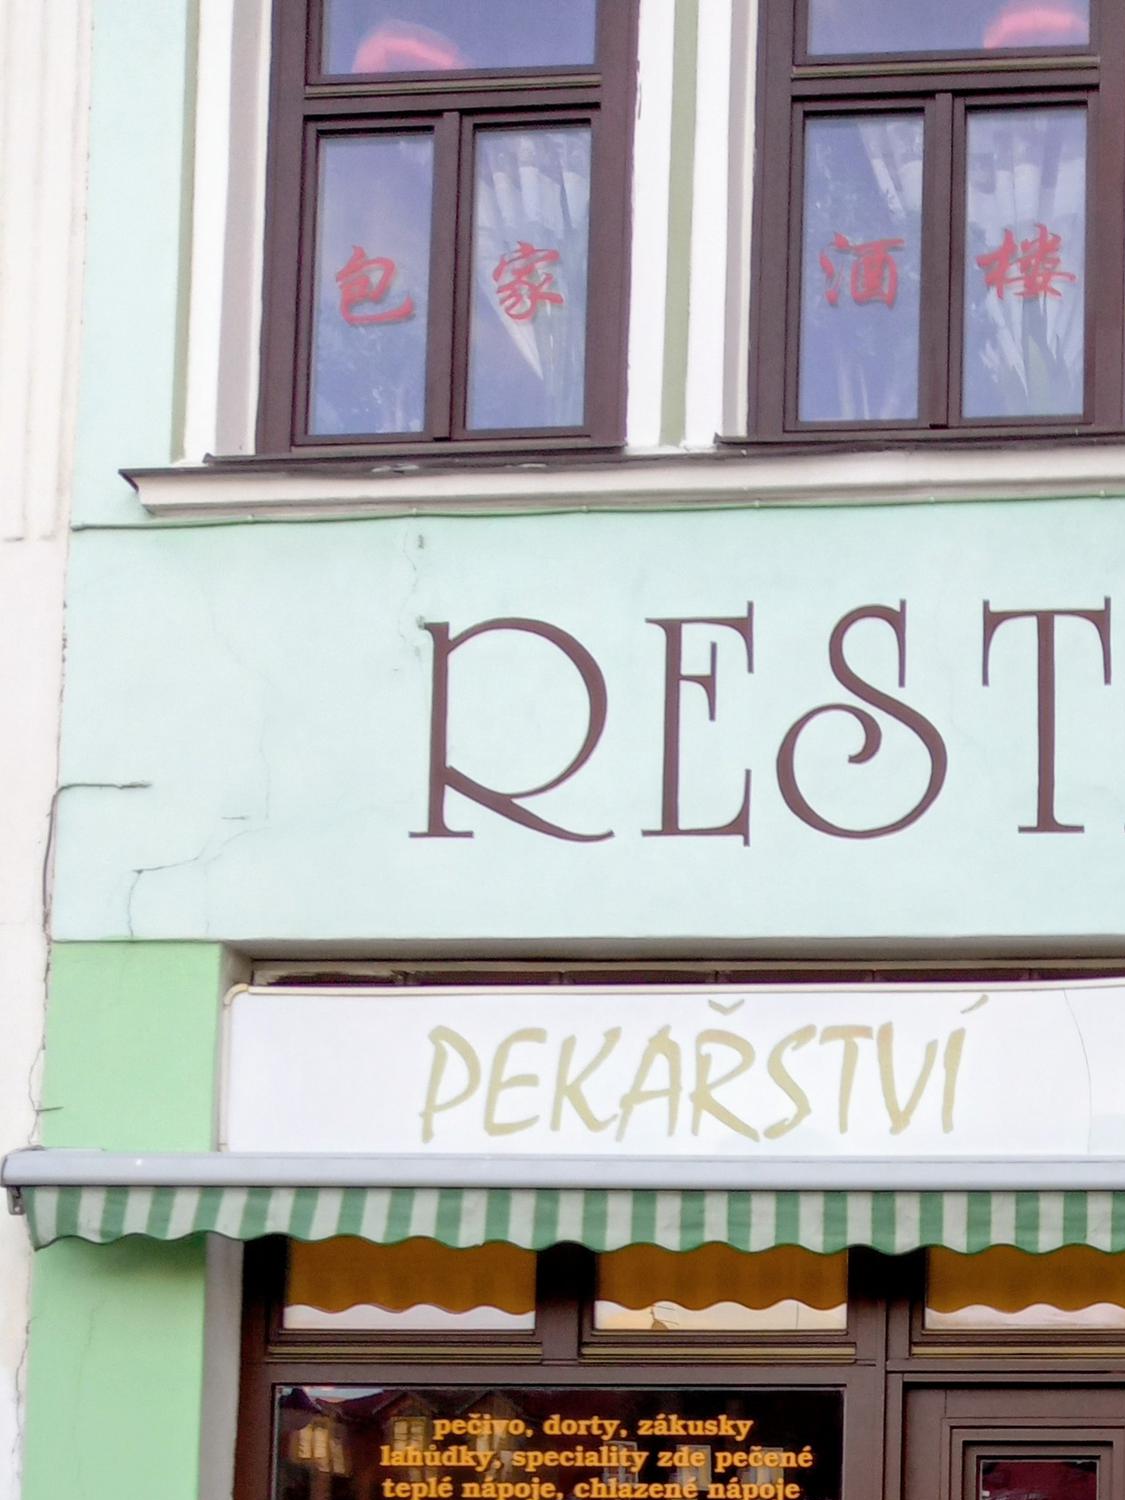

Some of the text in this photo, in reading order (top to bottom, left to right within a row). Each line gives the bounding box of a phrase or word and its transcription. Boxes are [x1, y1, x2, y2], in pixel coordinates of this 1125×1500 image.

[419, 993, 989, 1143] PEKAŘSTVÍ
[432, 1413, 753, 1442] pečivo, dorty, zákusky
[380, 1443, 813, 1474] lahůdky, speciality zde pečené
[573, 1477, 699, 1500] chlazené
